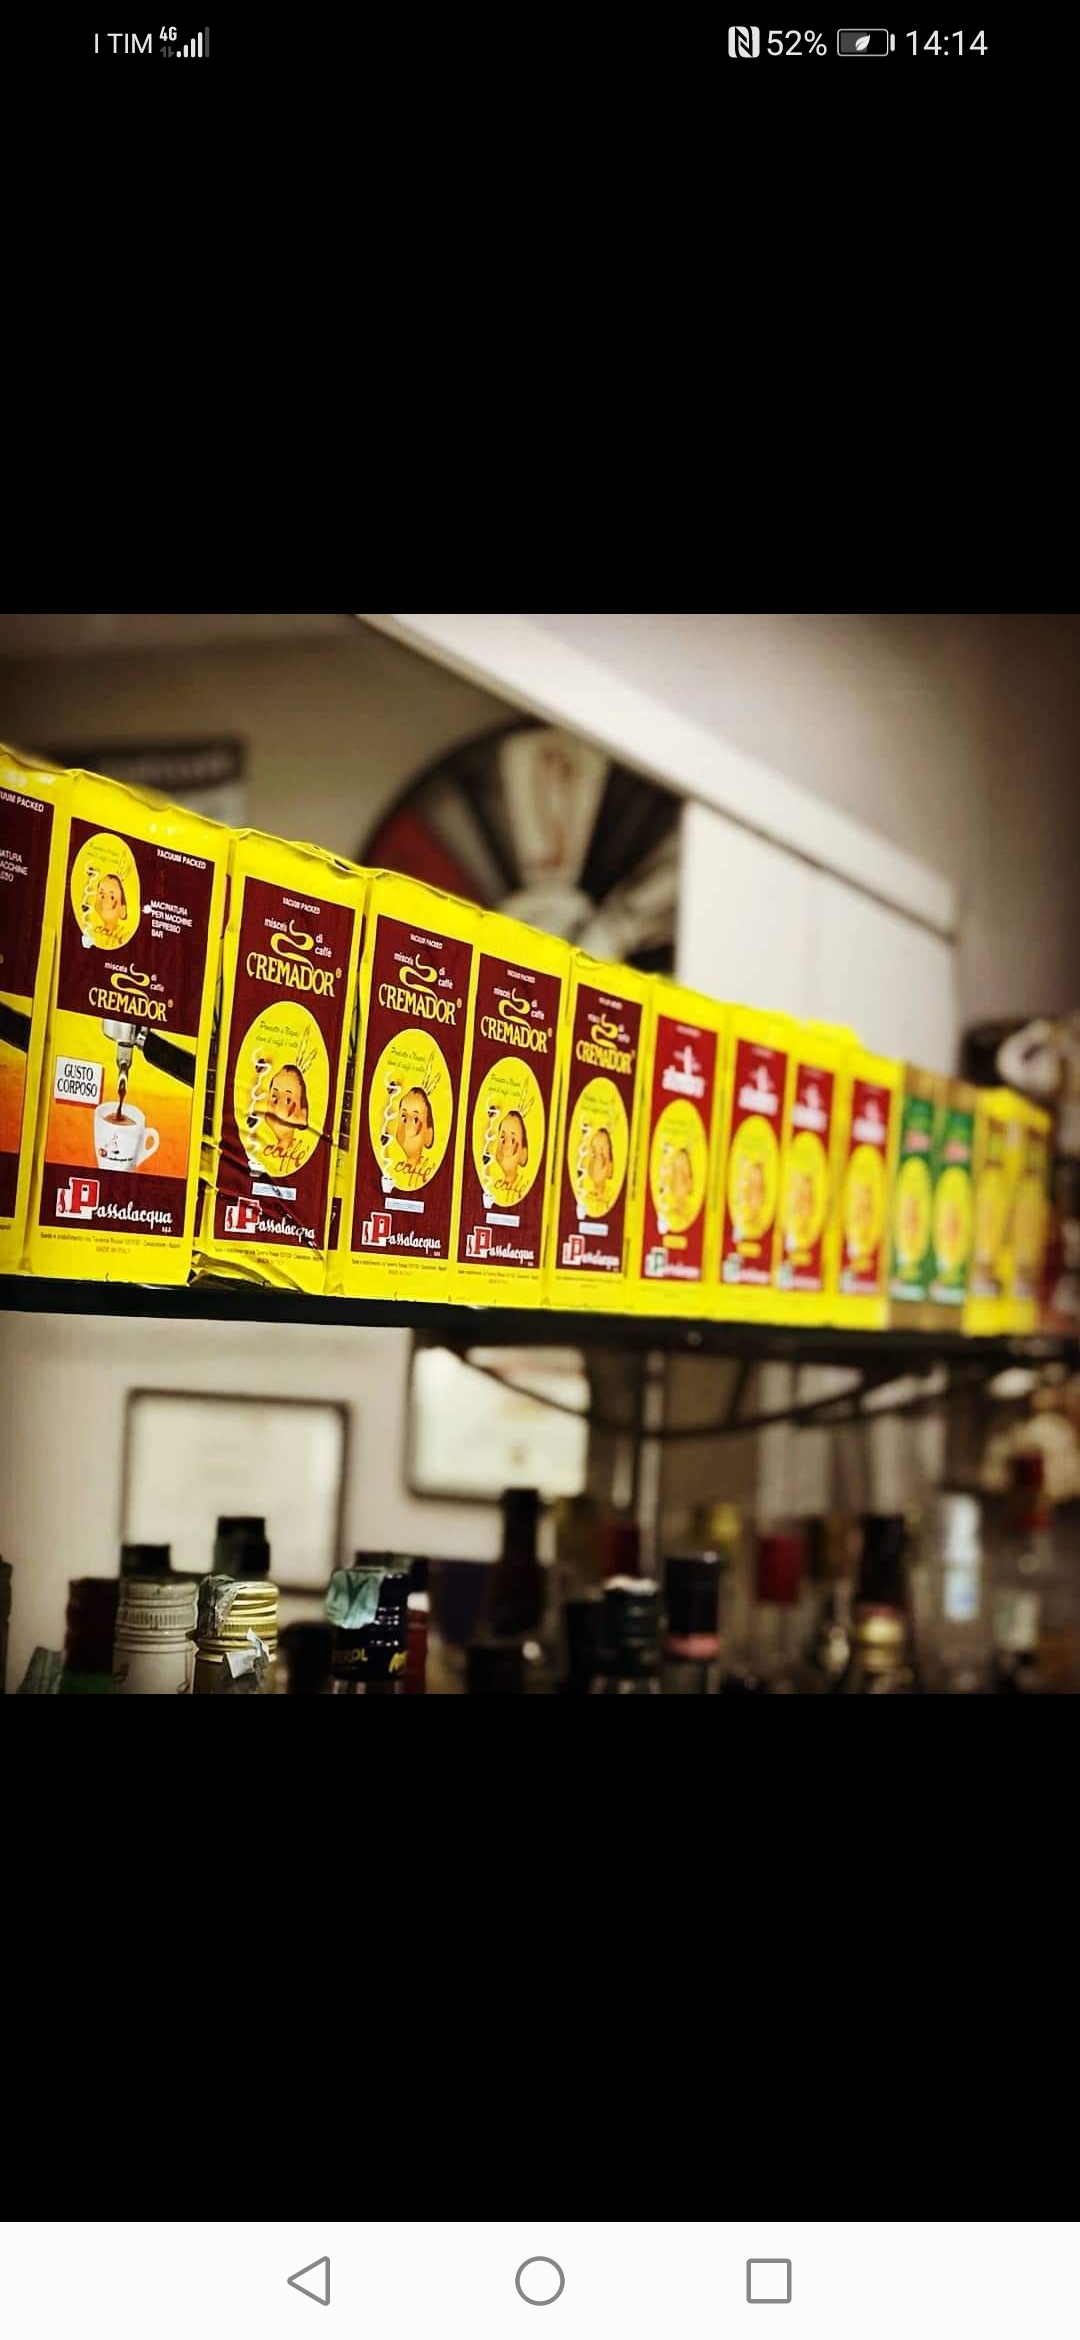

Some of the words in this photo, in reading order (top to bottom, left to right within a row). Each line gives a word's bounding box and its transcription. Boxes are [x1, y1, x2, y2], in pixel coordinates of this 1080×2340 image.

[16, 796, 44, 813] PACKED
[156, 848, 182, 863] VACUUM
[182, 856, 207, 870] PACKED
[246, 951, 335, 998] CREMADOR
[88, 987, 168, 1022] CREMADOR
[378, 983, 457, 1026] CREMADOR
[480, 1015, 548, 1054] CREMADOR
[57, 1078, 98, 1097] CORPOSO
[64, 1063, 94, 1081] GUSTO
[69, 1177, 173, 1231] Passalacqua
